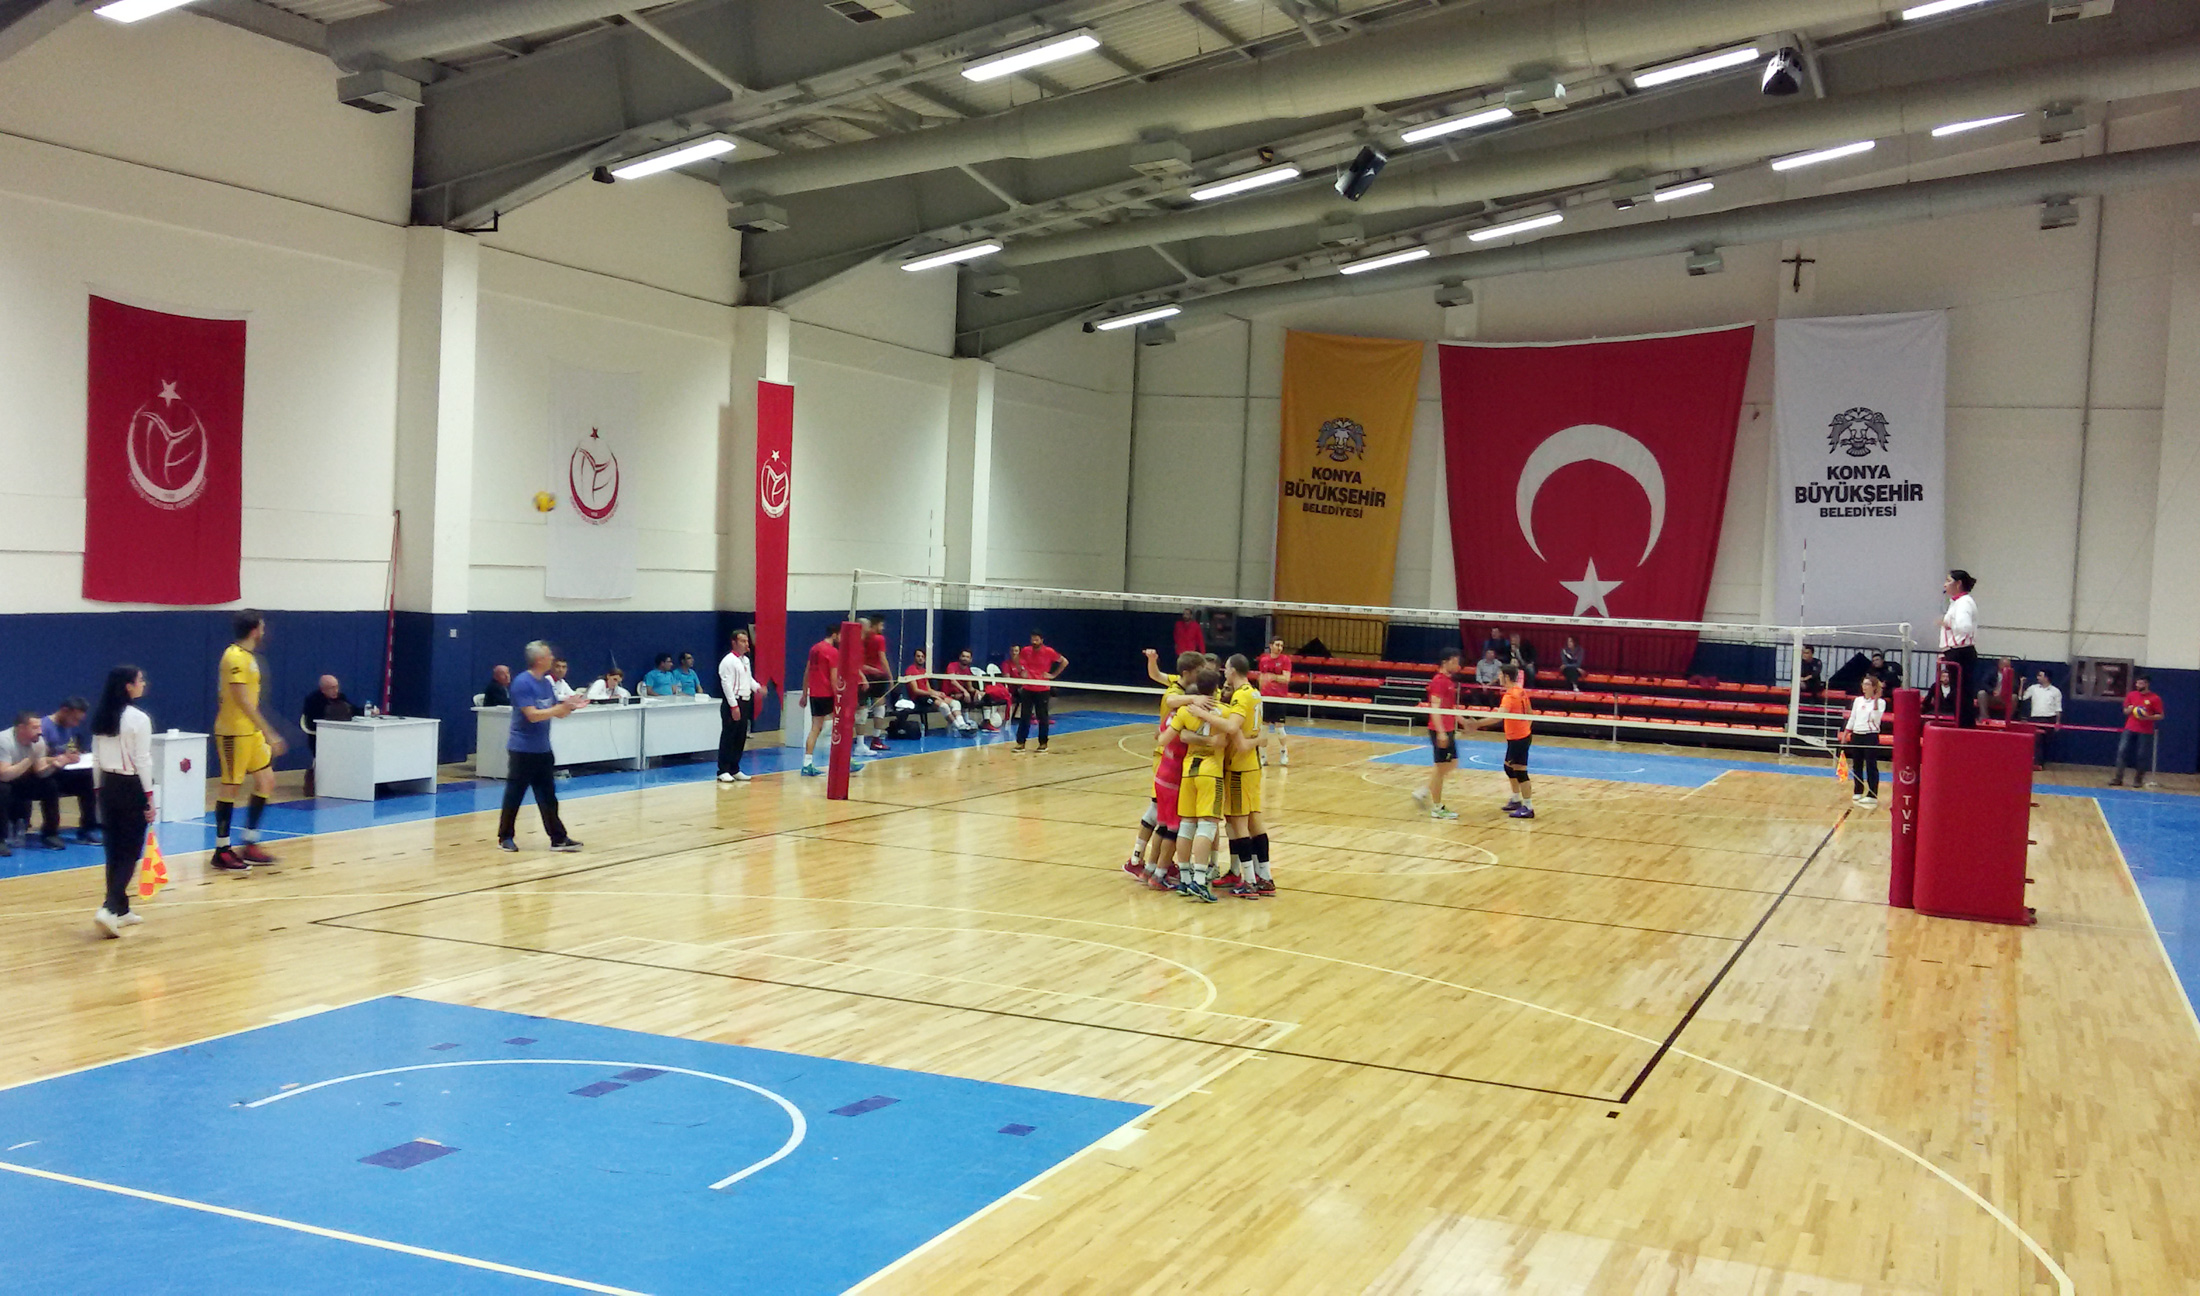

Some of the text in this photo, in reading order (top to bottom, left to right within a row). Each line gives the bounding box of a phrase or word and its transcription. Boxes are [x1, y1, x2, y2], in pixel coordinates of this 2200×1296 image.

[1311, 466, 1362, 484] KONYA
[1827, 464, 1891, 480] KONYA
[1284, 478, 1386, 507] BÜYÜKŞEHİR
[1795, 480, 1923, 505] BÜYÜKŞEHİR
[1302, 502, 1363, 518] BELEDİYESİ
[1819, 504, 1897, 518] BELEDİYESİ
[834, 695, 842, 726] TVF
[1902, 795, 1912, 834] TVF
